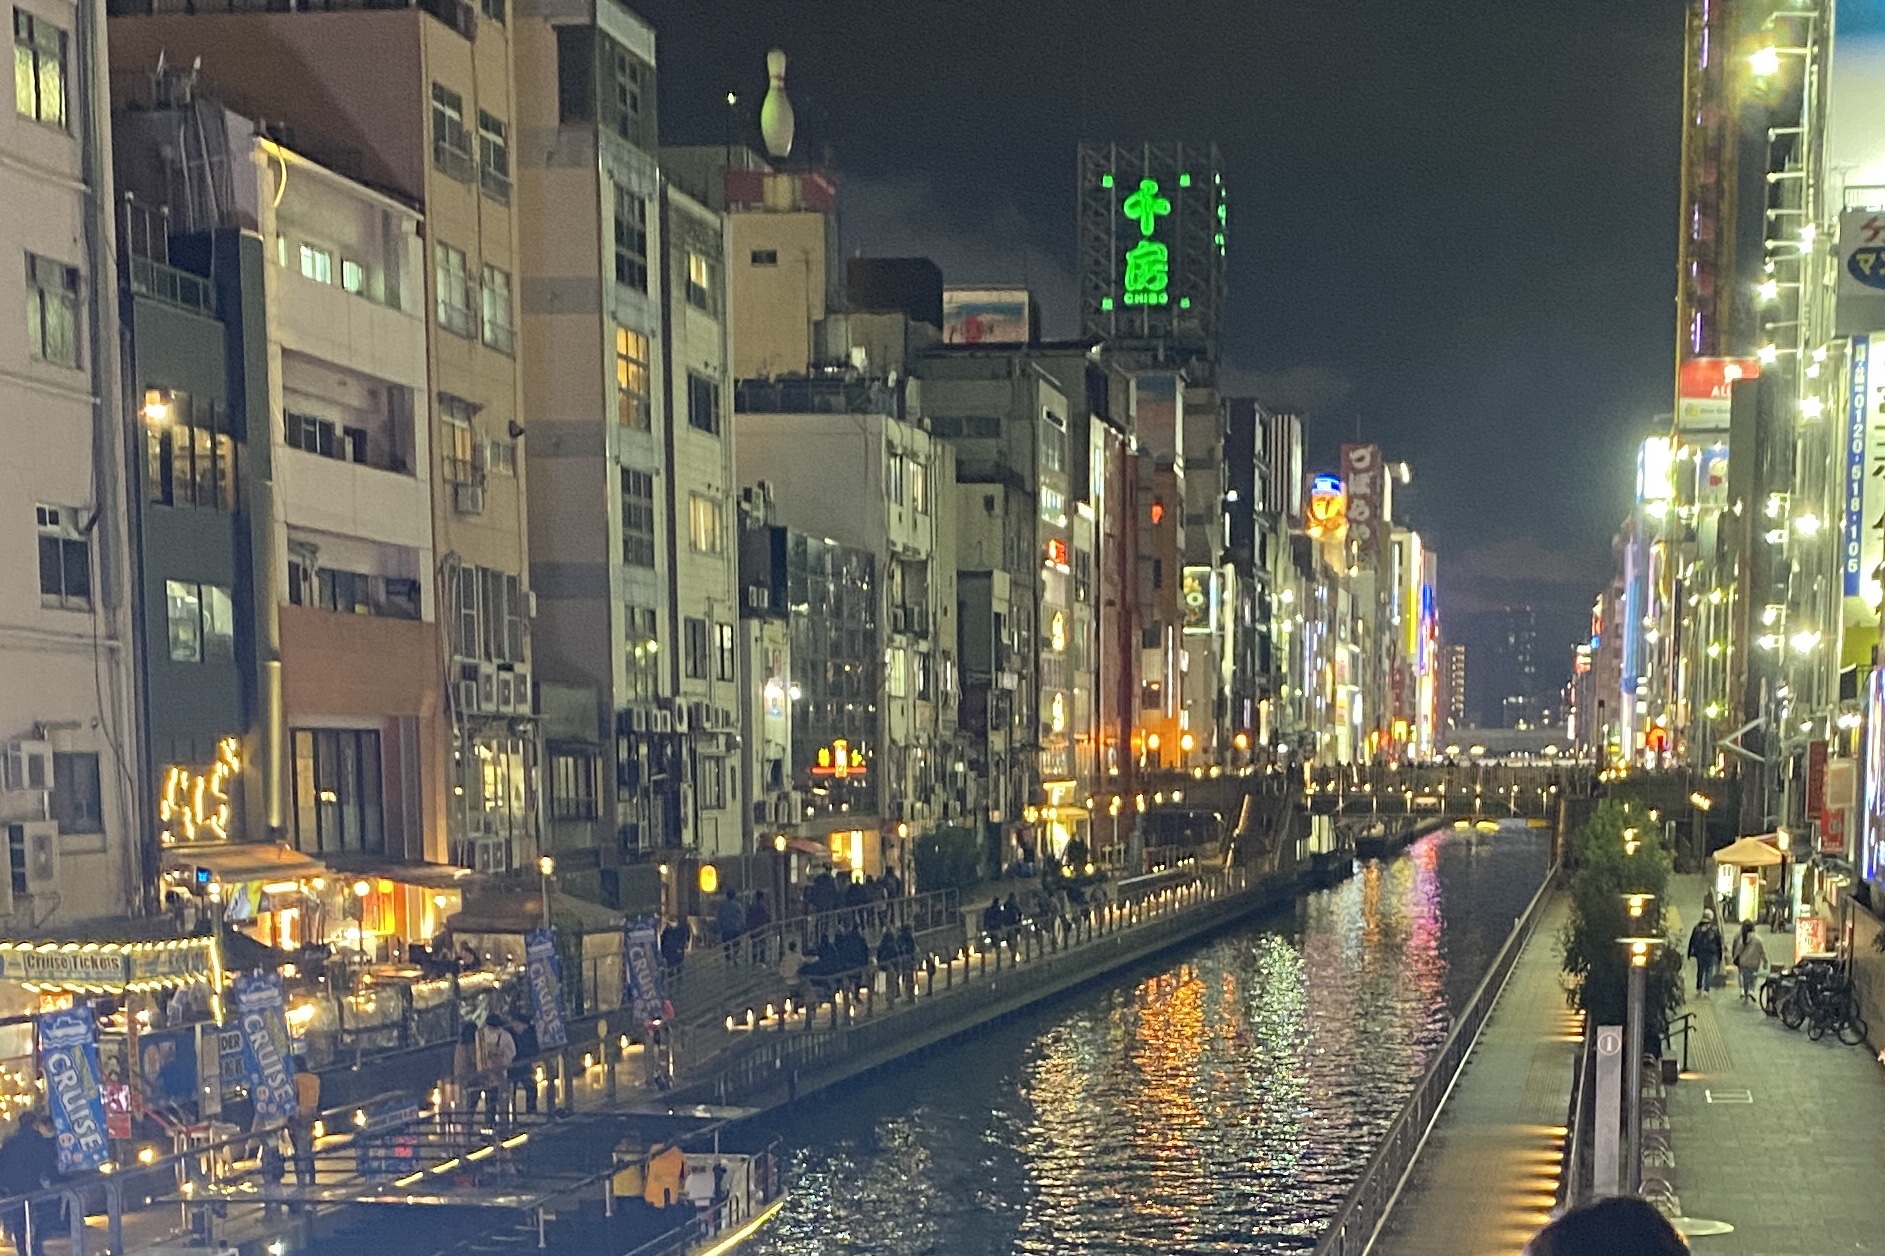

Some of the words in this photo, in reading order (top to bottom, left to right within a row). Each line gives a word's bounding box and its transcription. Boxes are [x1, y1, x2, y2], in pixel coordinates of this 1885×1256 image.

[27, 954, 69, 970] Cruise
[71, 955, 119, 971] Tickets
[244, 1014, 294, 1101] CRUISE
[48, 1052, 103, 1152] CRUISE
